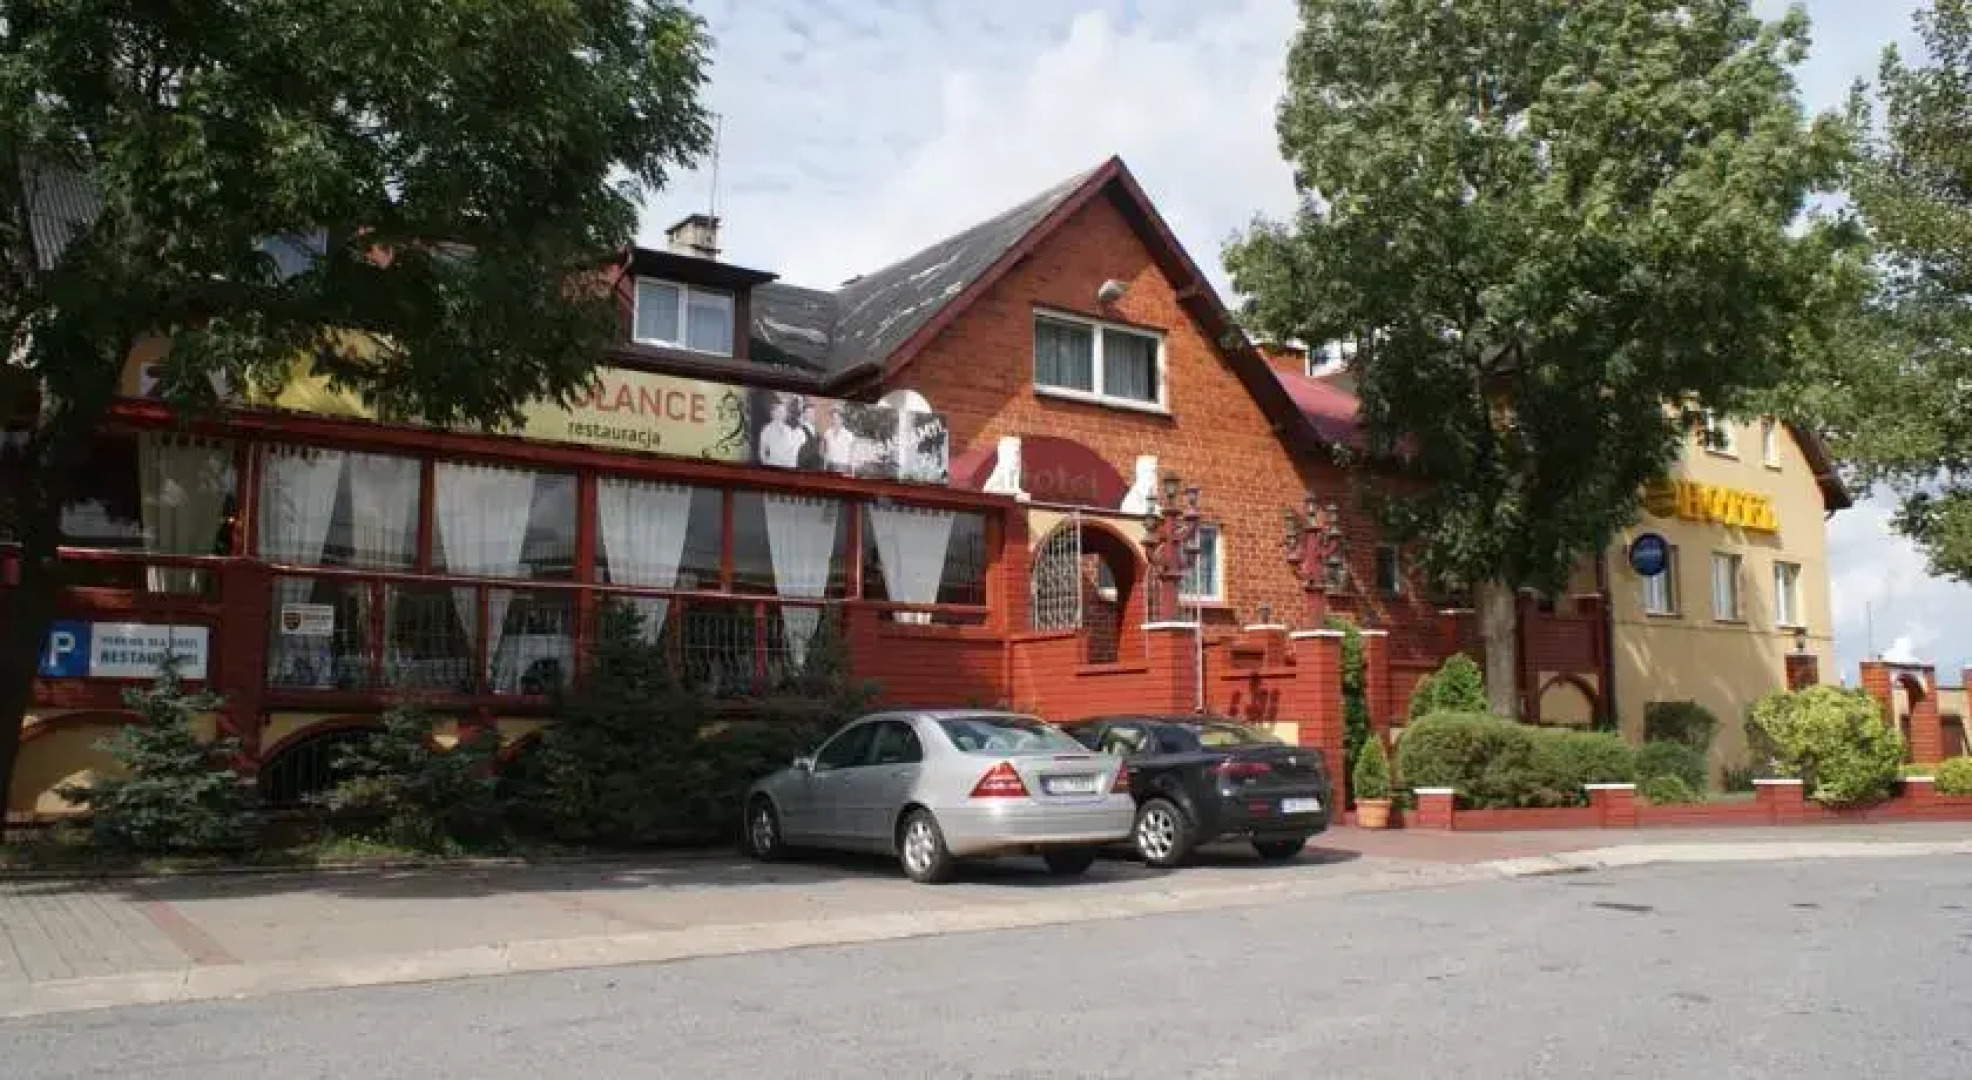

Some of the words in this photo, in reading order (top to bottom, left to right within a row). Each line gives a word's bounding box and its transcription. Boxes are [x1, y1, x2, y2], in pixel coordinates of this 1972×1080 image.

[567, 422, 661, 447] restauracja
[1674, 480, 1778, 531] HOTEL
[49, 631, 75, 667] P
